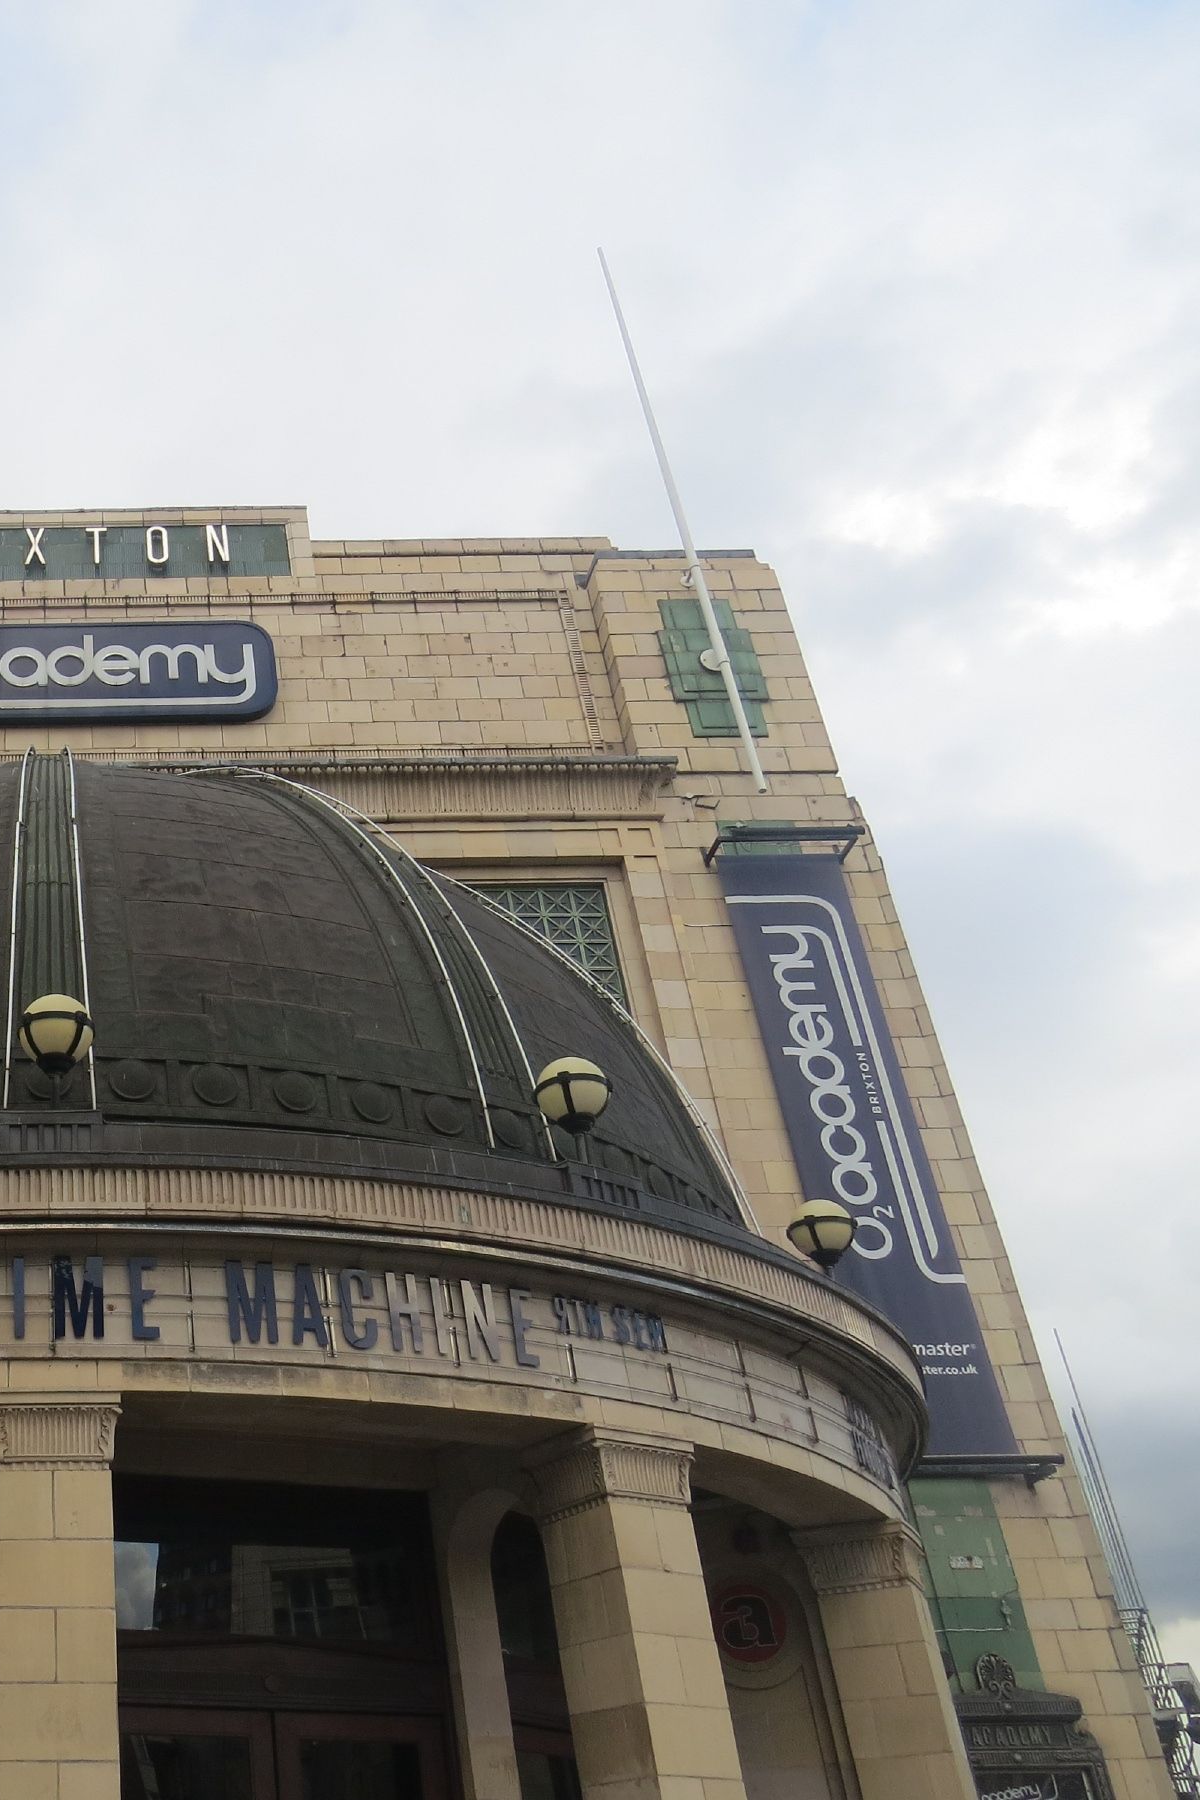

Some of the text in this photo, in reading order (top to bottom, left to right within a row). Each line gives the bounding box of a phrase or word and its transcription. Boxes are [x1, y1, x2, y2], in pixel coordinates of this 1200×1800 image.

[761, 925, 878, 1206] academy
[856, 1051, 883, 1115] BRIXTON
[224, 1260, 540, 1367] MACHINE
[971, 1725, 1051, 1747] ACADEMY
